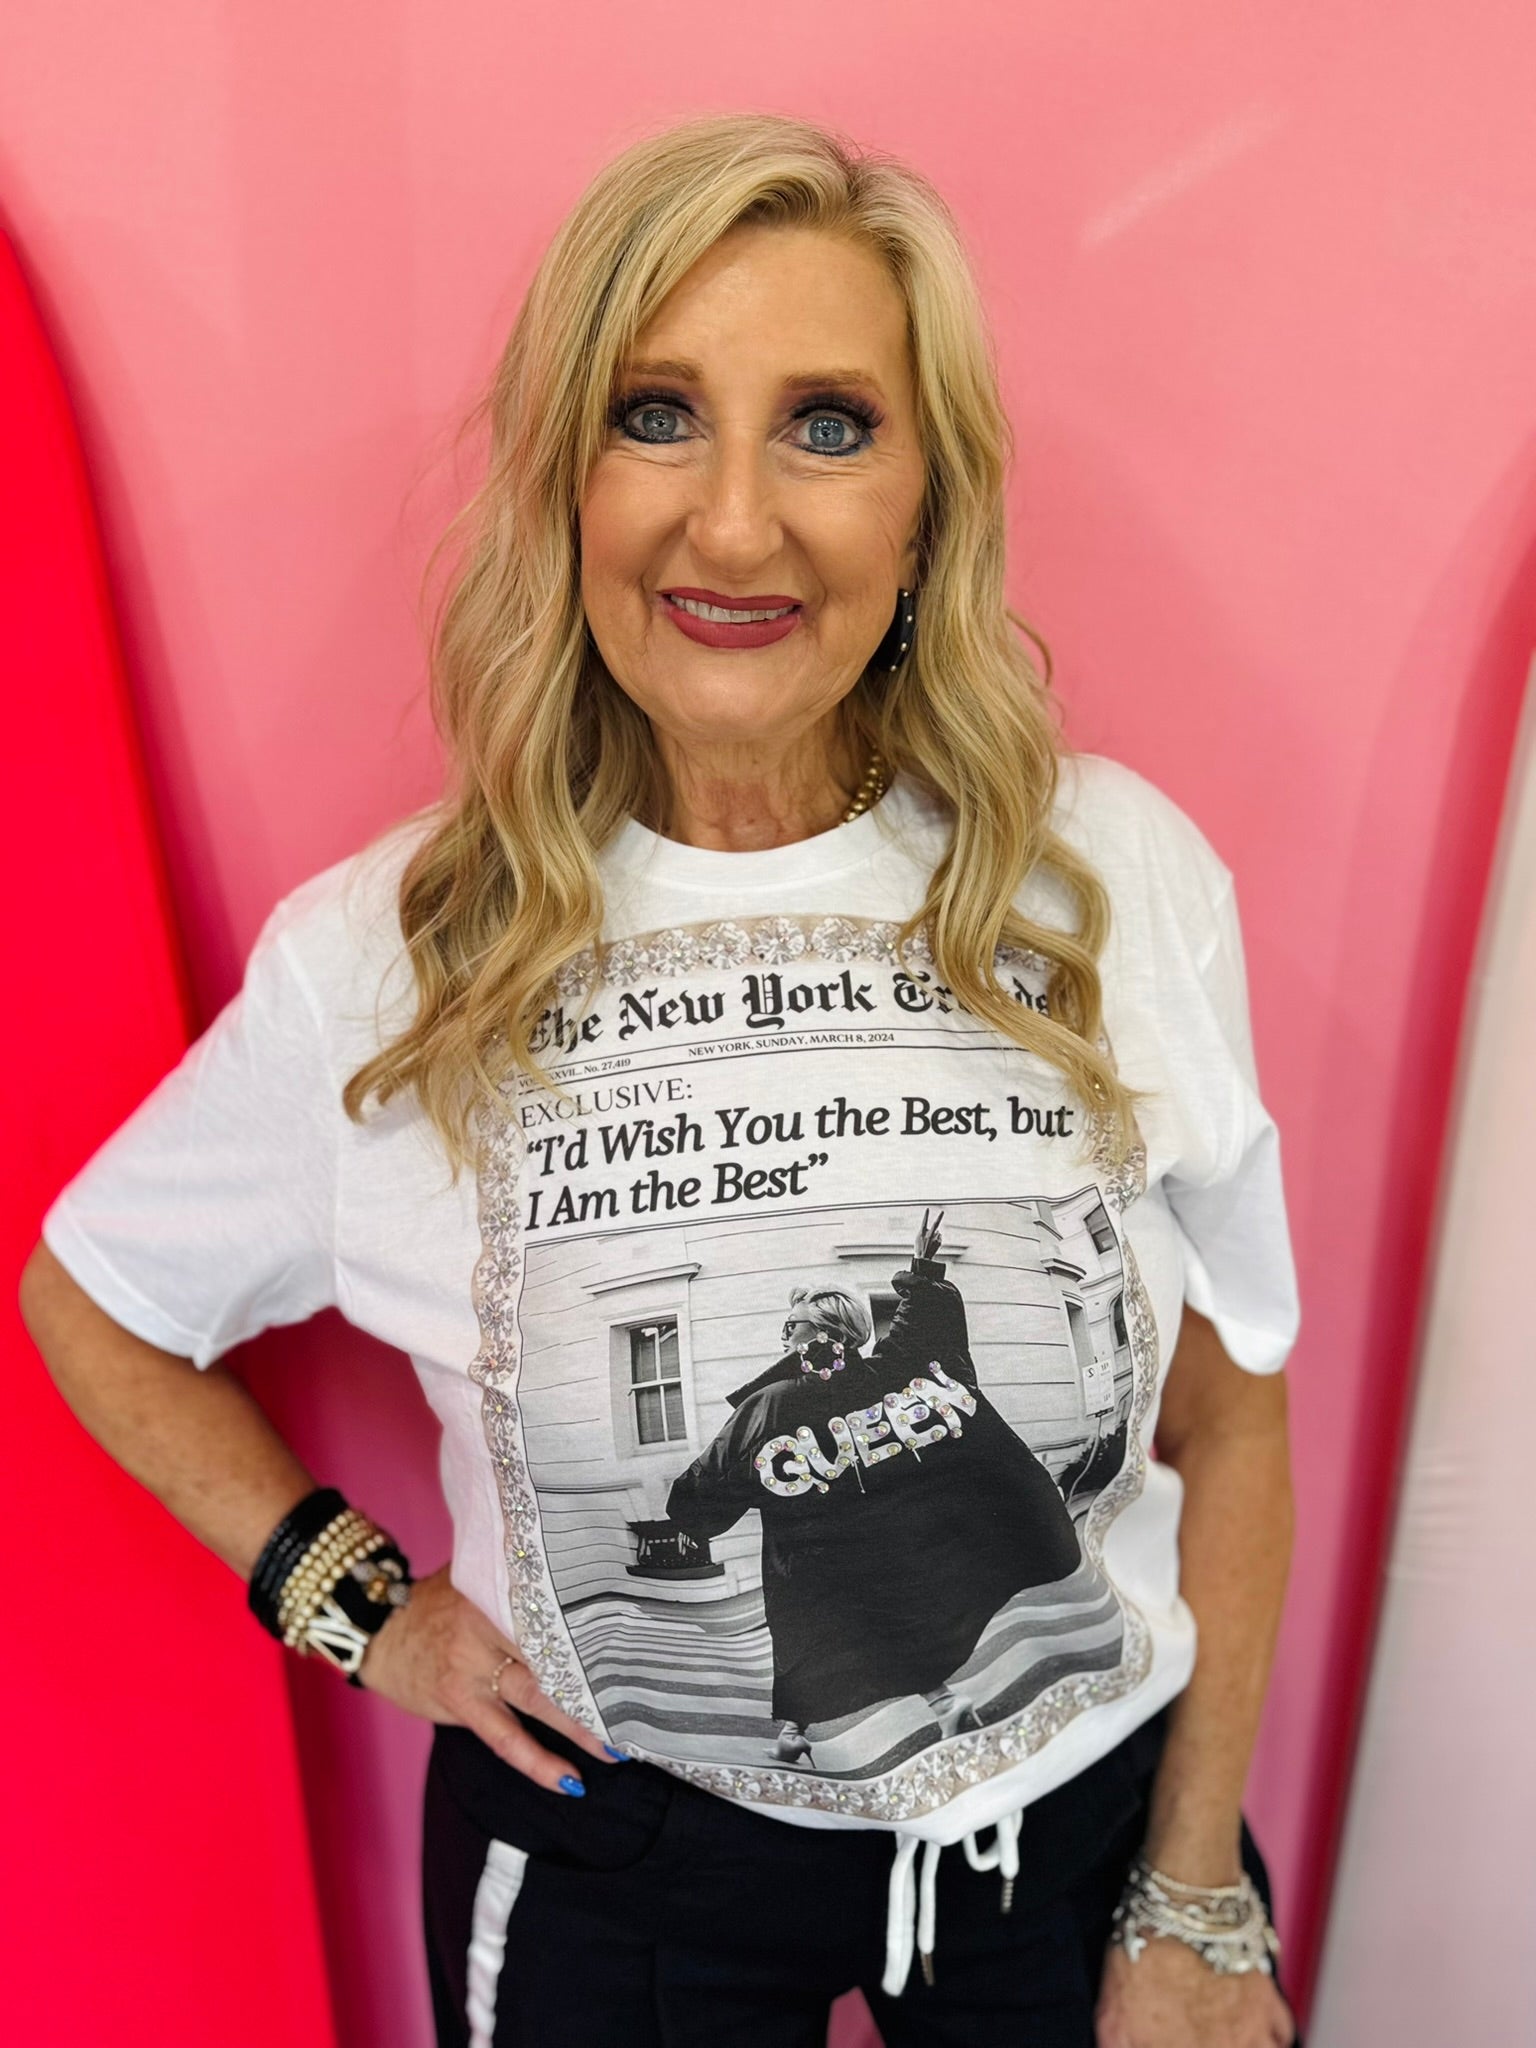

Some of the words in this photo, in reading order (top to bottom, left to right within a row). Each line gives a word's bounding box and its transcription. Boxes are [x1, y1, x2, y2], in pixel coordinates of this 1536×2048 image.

[618, 986, 726, 1041] New
[741, 969, 877, 1030] York
[584, 1064, 600, 1074] No.
[688, 1046, 716, 1057] NEW
[809, 1033, 853, 1044] MARCH
[867, 1032, 895, 1042] 2024
[520, 1077, 693, 1129] EXCLUSIVE:
[598, 1112, 706, 1165] Wish
[715, 1106, 805, 1149] You
[814, 1096, 890, 1139] the
[900, 1096, 998, 1142] Best,
[1006, 1095, 1074, 1138] but
[524, 1190, 544, 1231] I
[546, 1185, 620, 1228] Am
[629, 1169, 702, 1214] the
[710, 1152, 829, 1205] Best”
[754, 1360, 977, 1497] QUEEN
